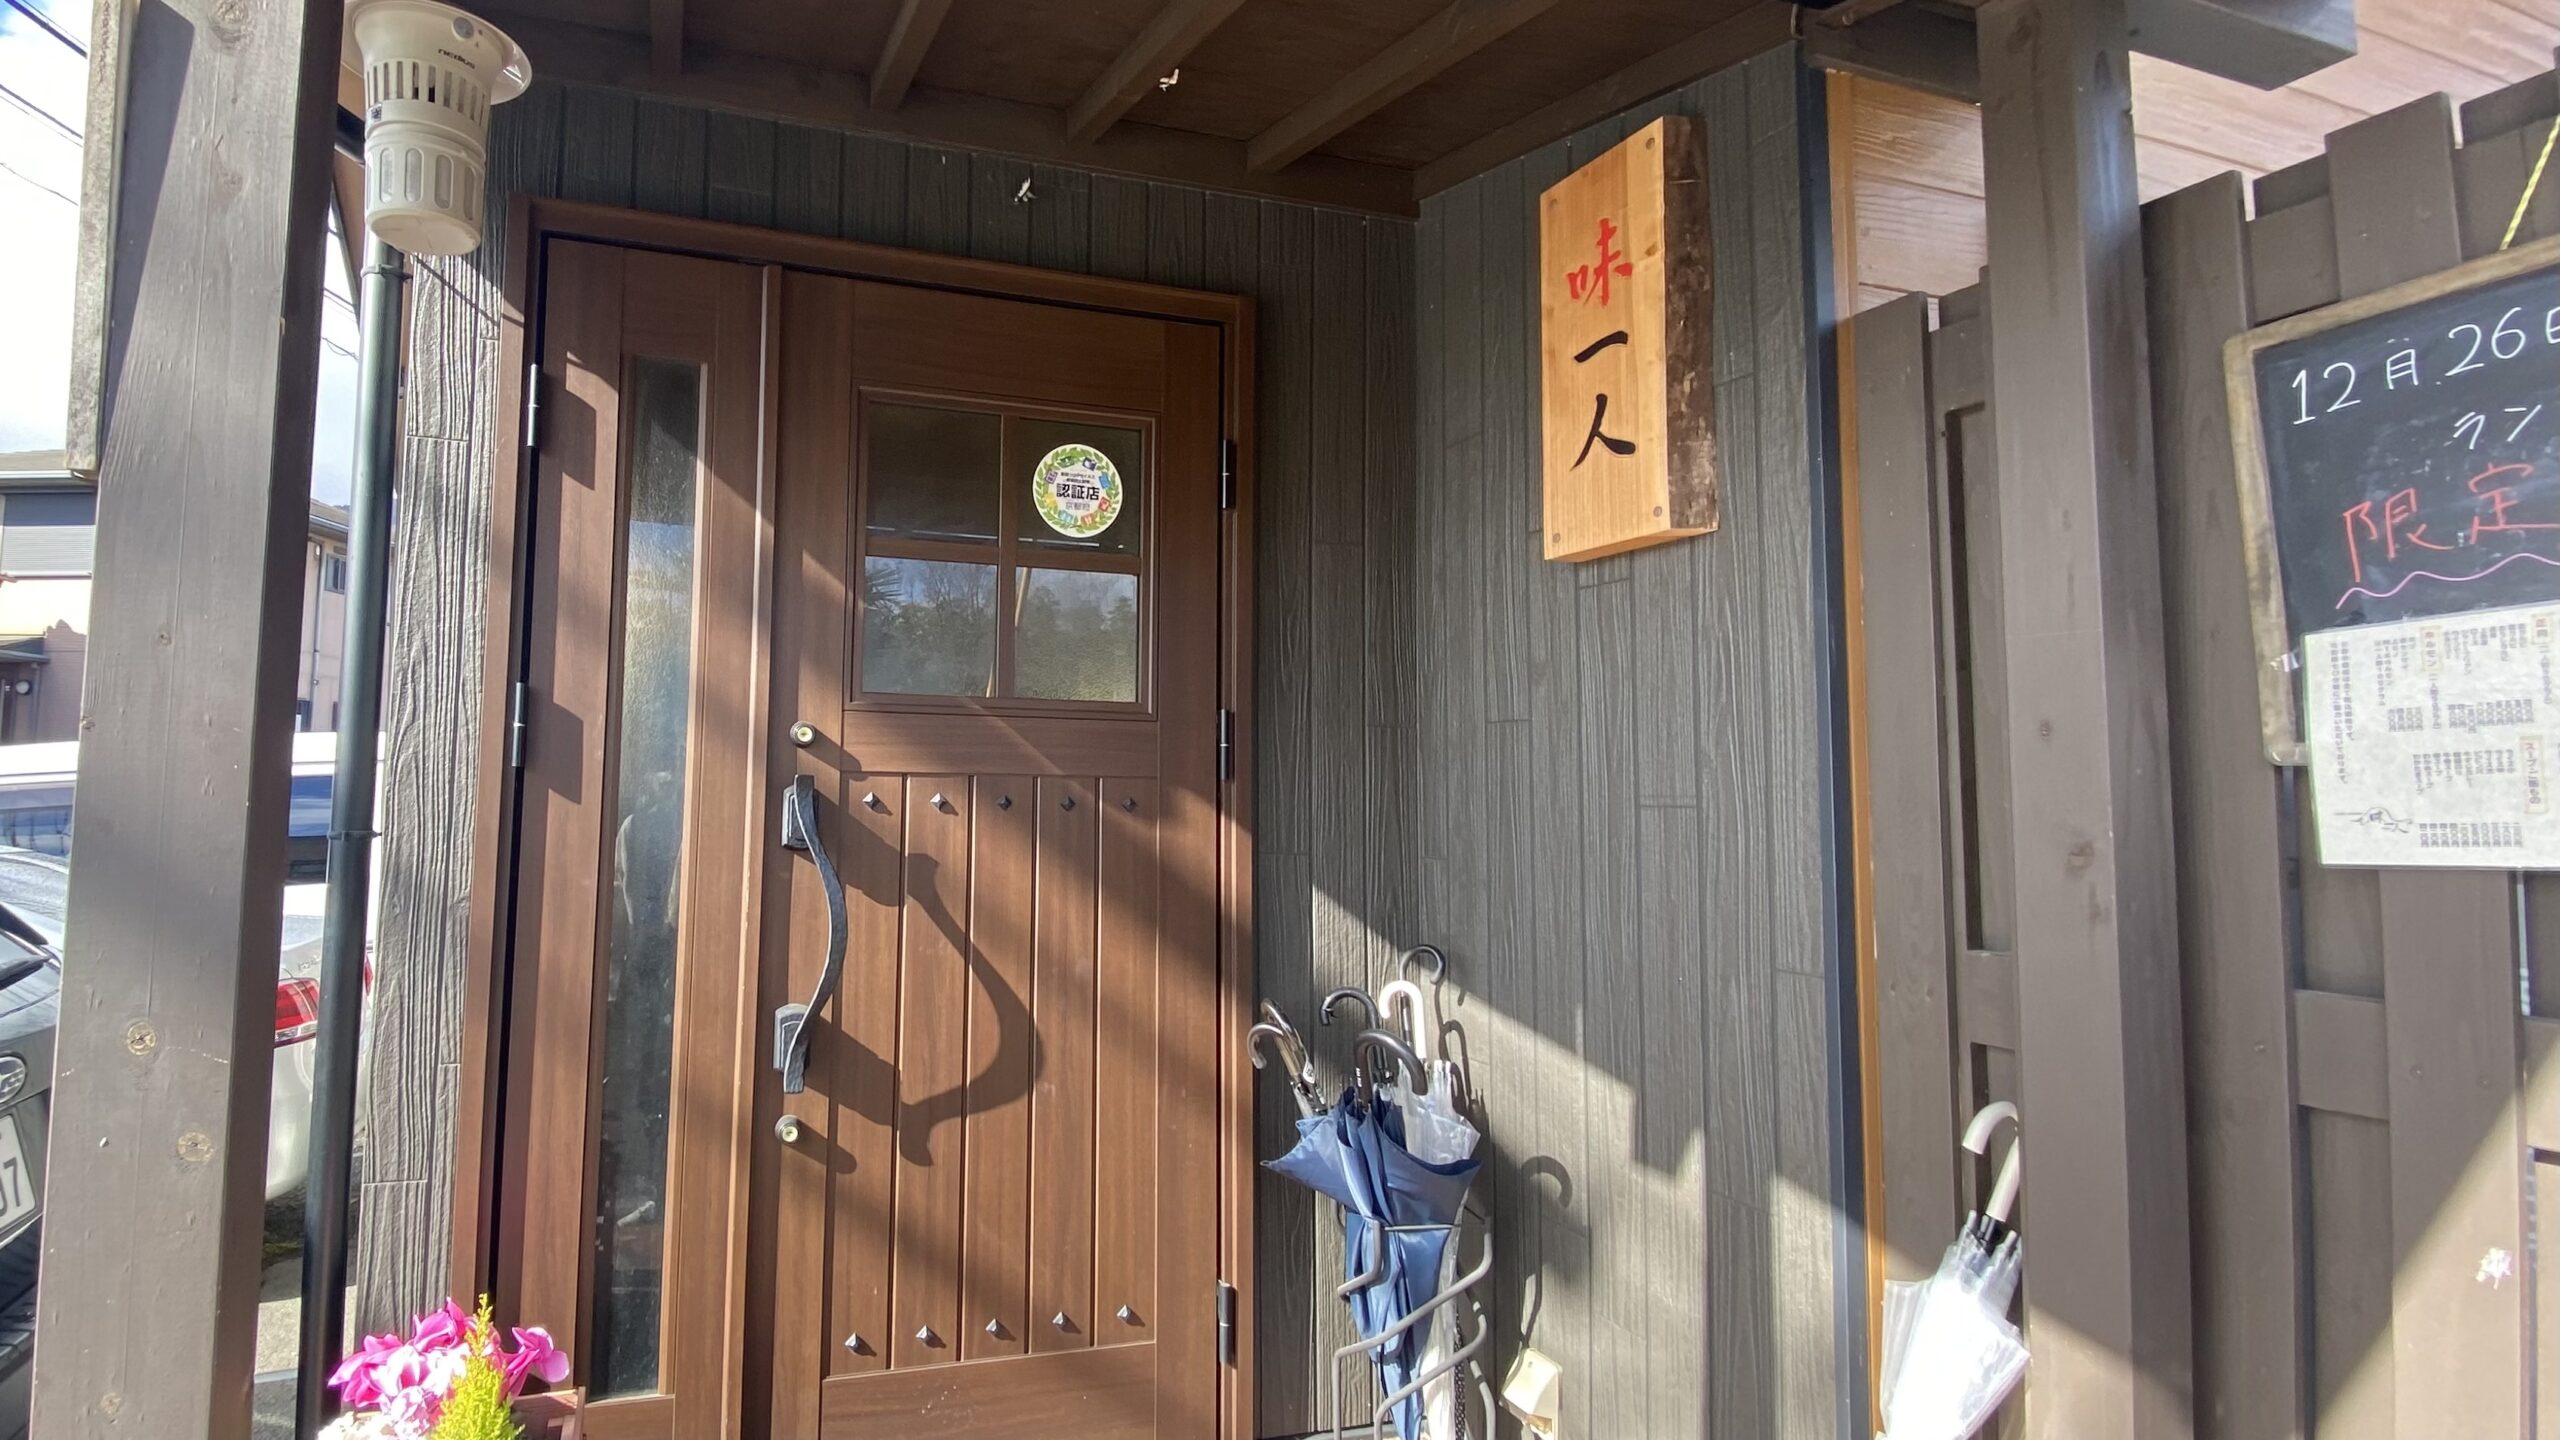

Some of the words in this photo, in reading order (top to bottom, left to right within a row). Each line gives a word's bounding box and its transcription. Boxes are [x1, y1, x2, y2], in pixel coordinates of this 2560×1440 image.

[1566, 217, 1636, 472] 味一人
[1056, 483, 1100, 500] 認証店
[2342, 462, 2560, 584] 限定
